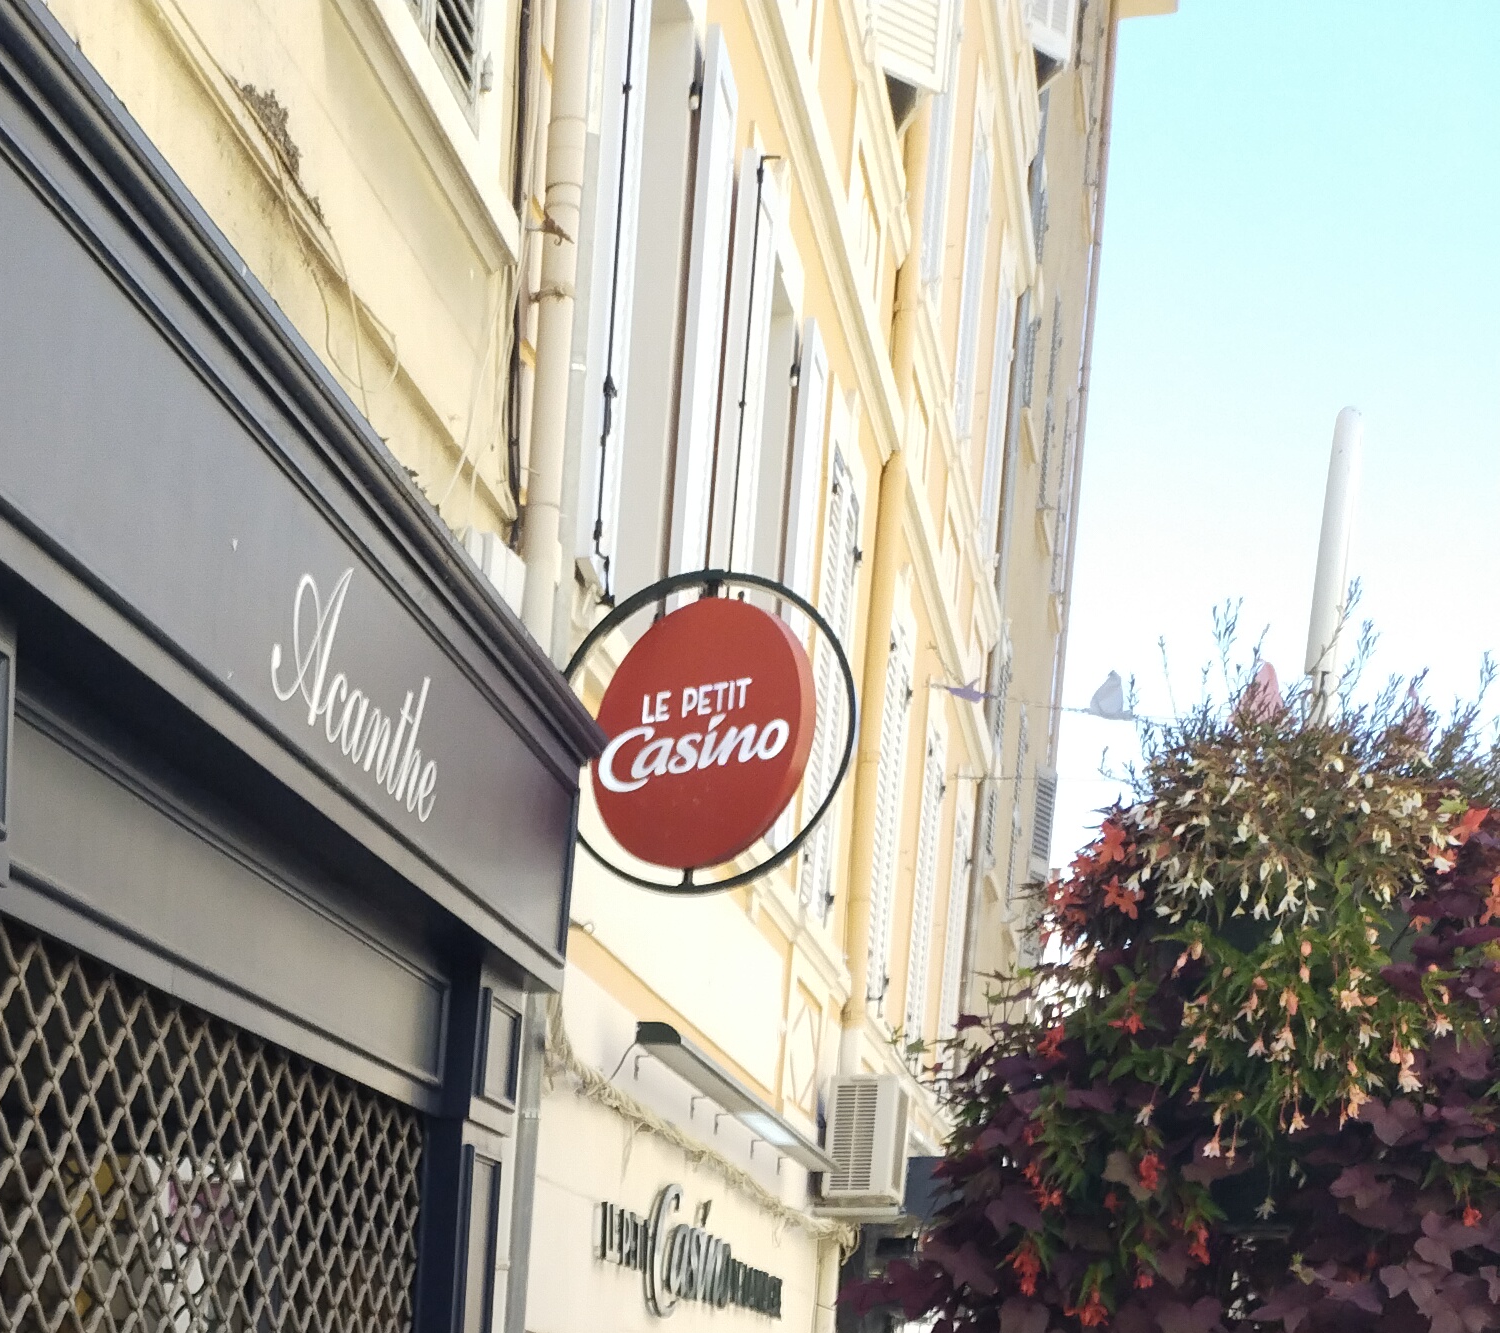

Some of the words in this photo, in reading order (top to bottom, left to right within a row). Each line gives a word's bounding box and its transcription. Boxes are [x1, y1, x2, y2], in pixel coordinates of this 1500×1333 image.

[270, 566, 438, 823] Acanthe
[641, 689, 672, 725] LE
[681, 676, 753, 719] PETIT
[598, 711, 790, 793] Casino
